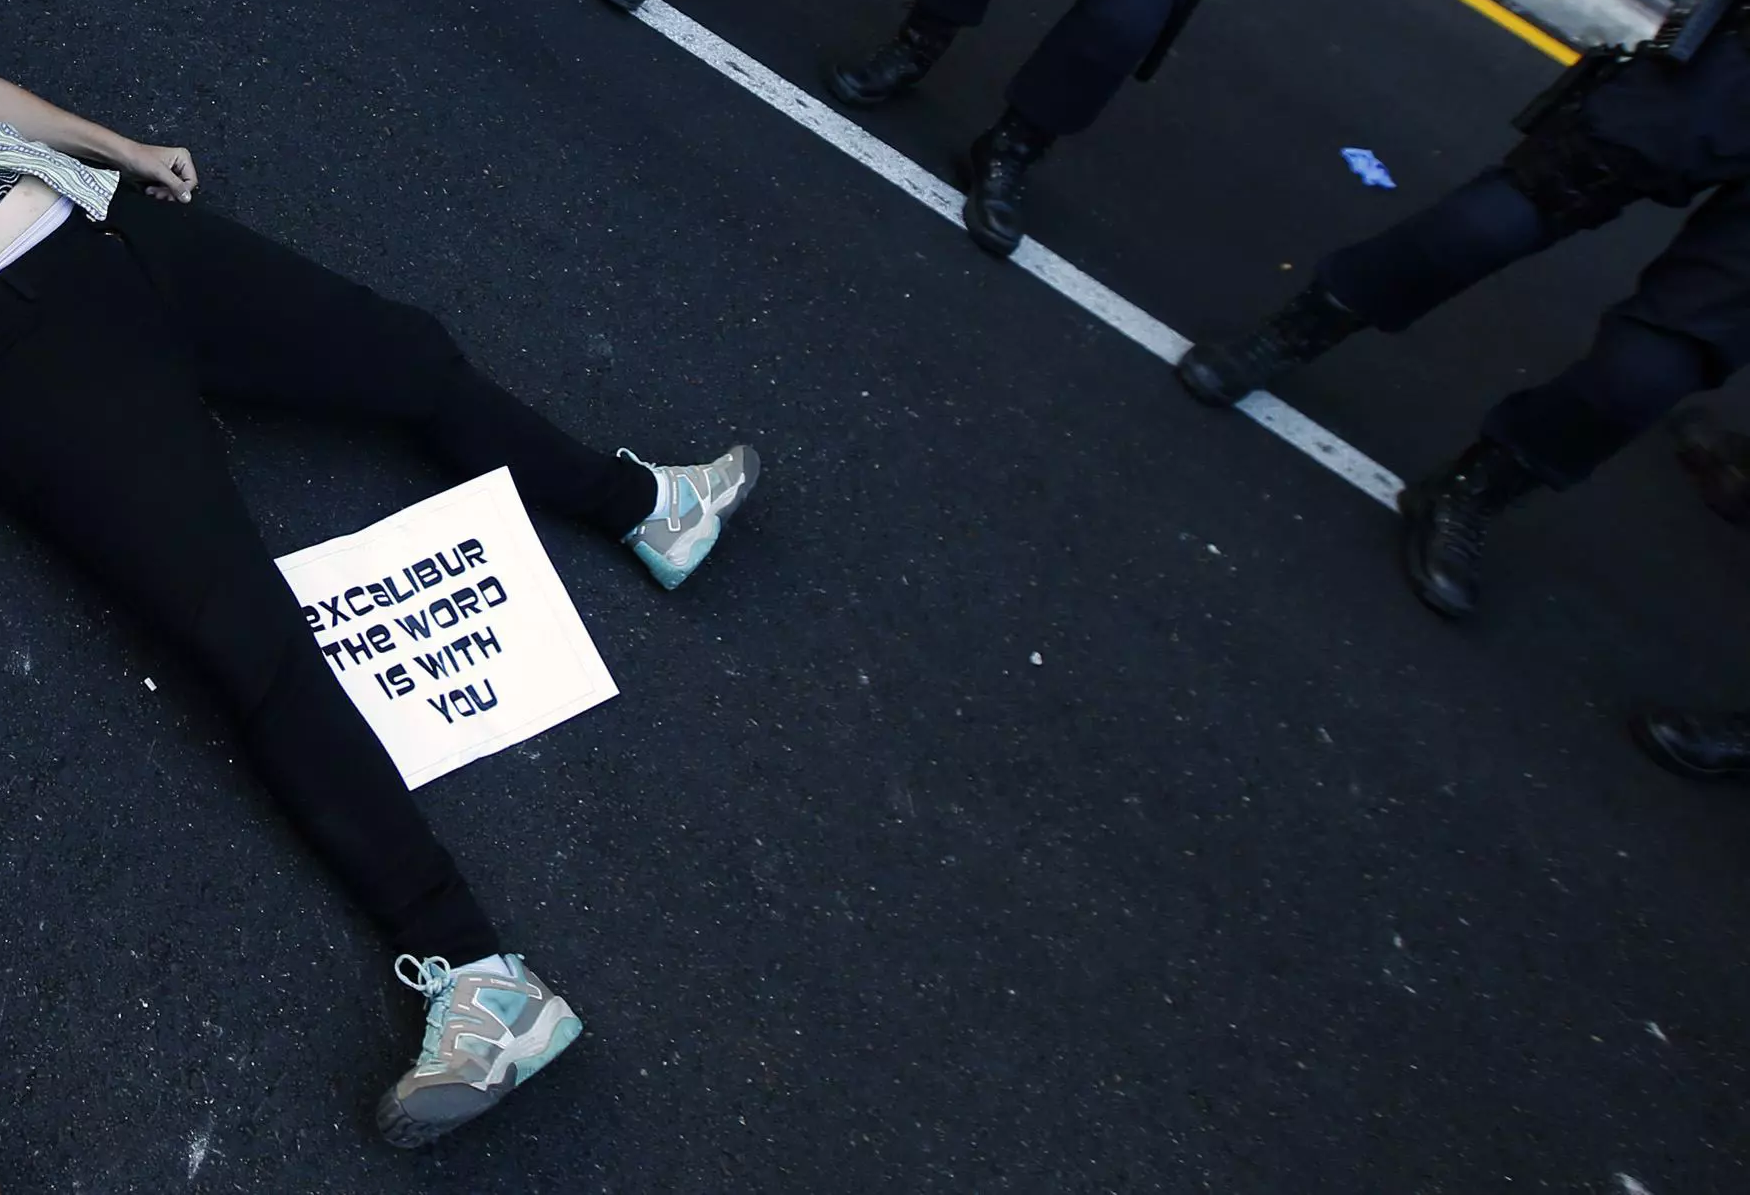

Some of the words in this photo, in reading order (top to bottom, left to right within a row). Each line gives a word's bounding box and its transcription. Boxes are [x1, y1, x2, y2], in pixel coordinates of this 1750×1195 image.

[394, 575, 508, 640] WORD
[374, 663, 416, 700] IS
[413, 626, 502, 678] WITH
[426, 678, 498, 724] YOU
